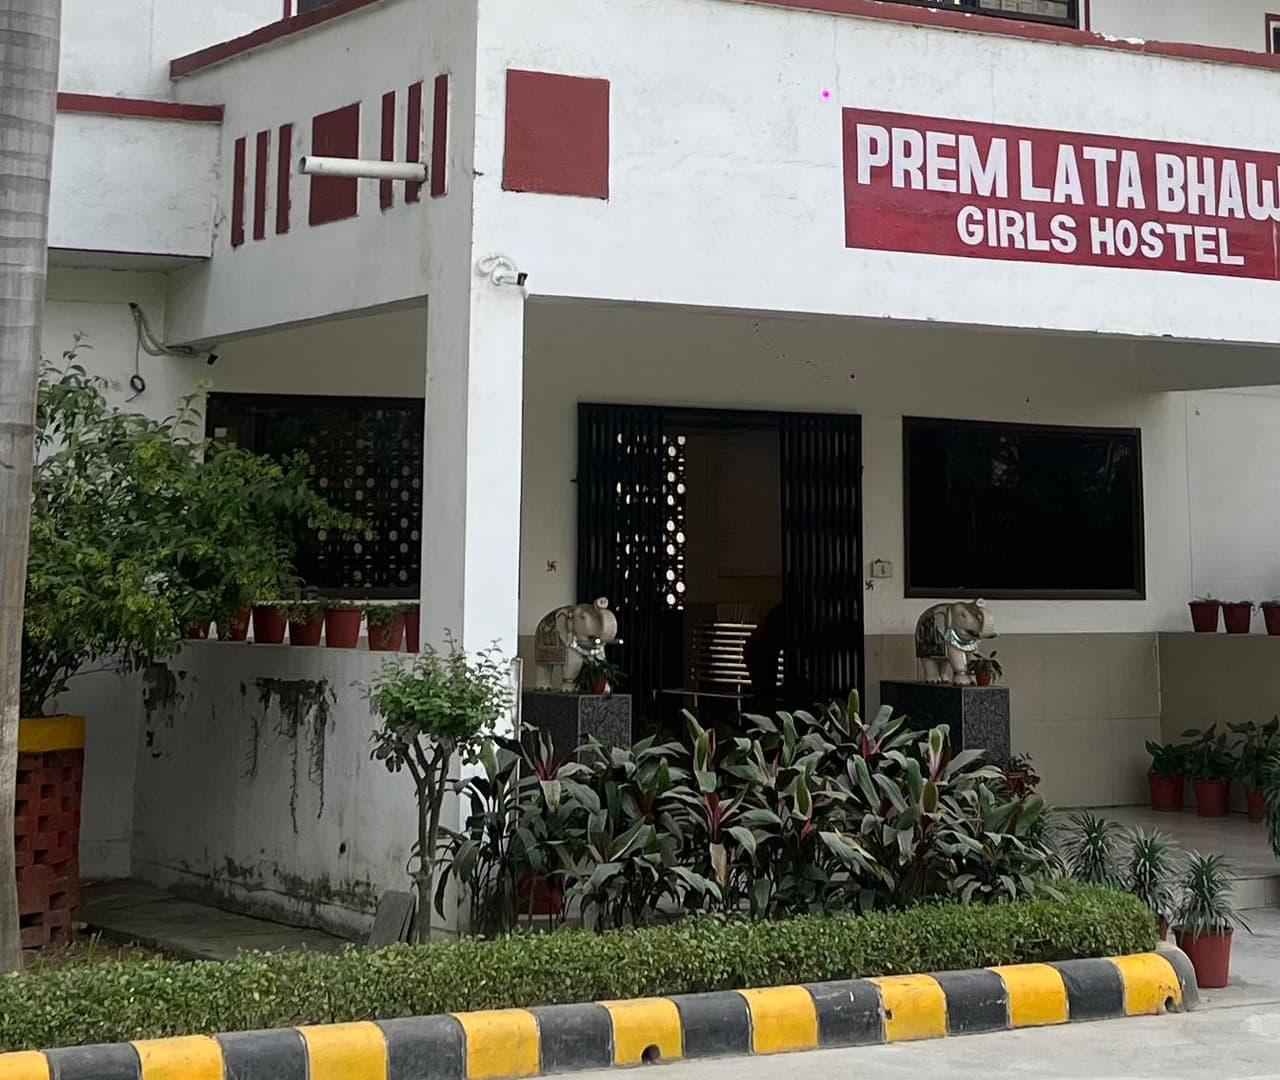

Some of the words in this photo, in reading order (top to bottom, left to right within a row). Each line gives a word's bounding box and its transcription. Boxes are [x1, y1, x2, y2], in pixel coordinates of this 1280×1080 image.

[856, 123, 1009, 199] PREM
[1018, 139, 1146, 210] LATA
[956, 205, 1077, 254] GIRLS
[1089, 216, 1245, 266] HOSTEL
